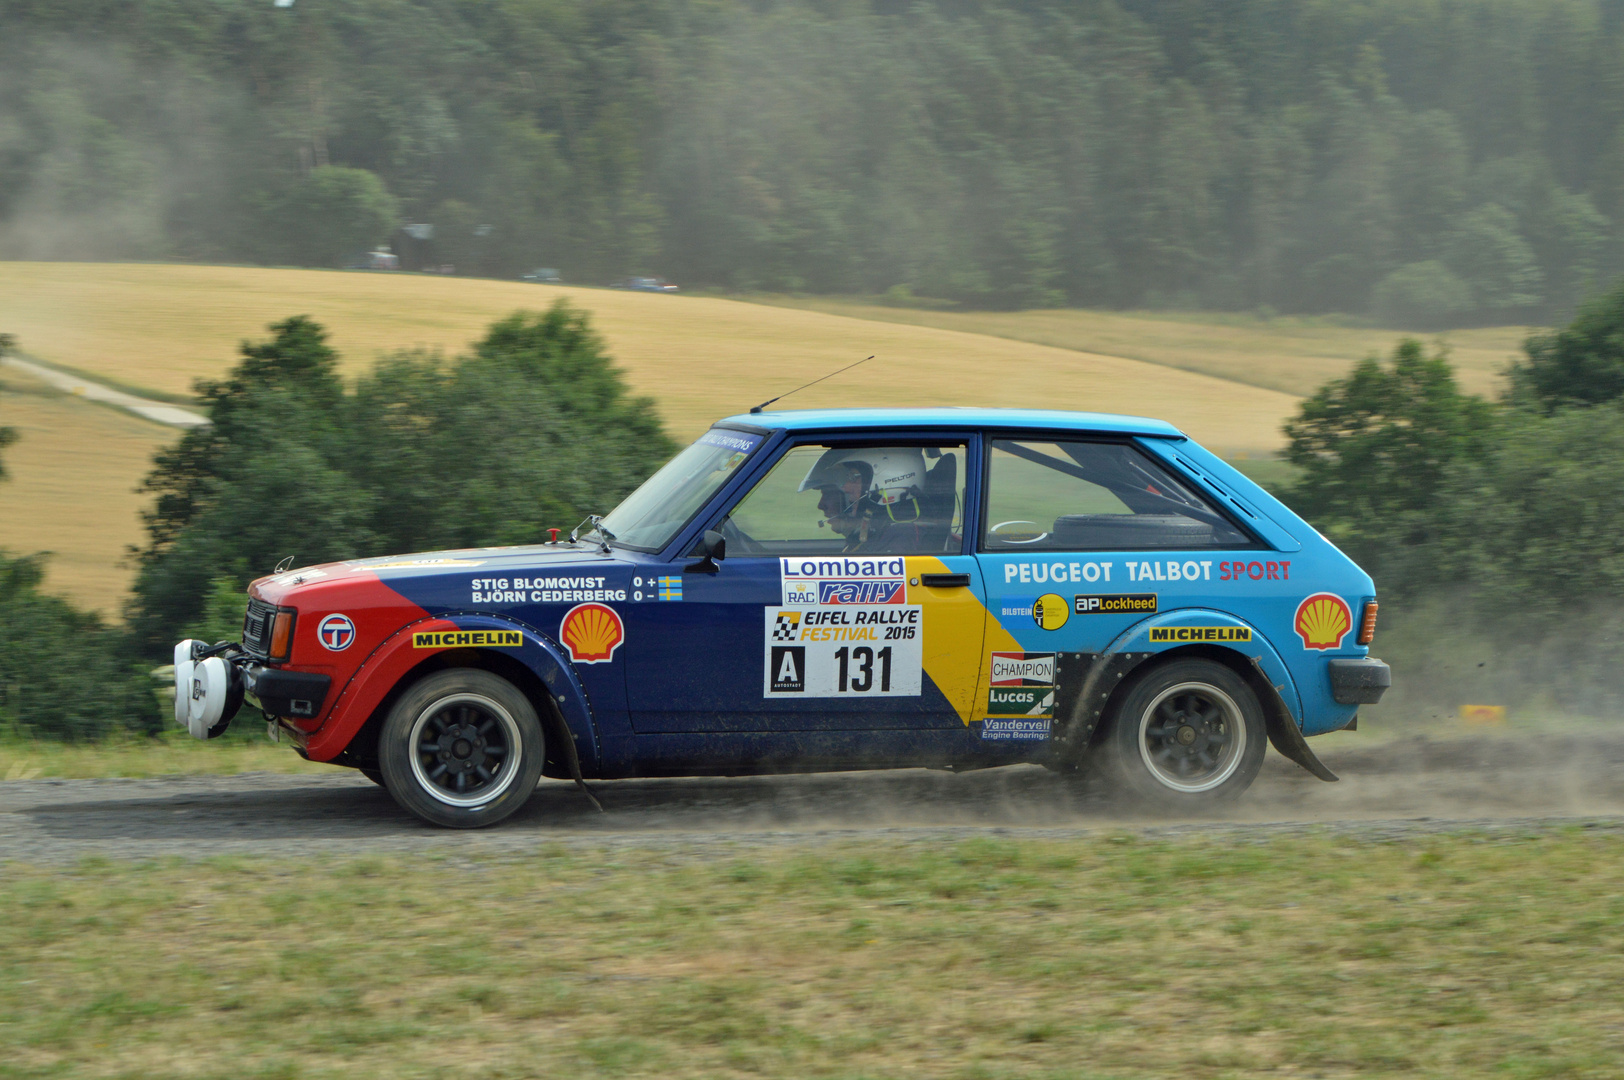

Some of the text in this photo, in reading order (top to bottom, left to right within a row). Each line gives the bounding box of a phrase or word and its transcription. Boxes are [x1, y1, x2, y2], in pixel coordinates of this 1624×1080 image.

[884, 472, 916, 484] PELTOR
[783, 558, 904, 576] Lombard
[1004, 561, 1291, 583] PEUGEOT TALBOT SPORT
[471, 579, 509, 590] STIG
[513, 577, 606, 589] BLOMQVIST
[472, 588, 526, 603] BJÖRN
[530, 589, 627, 602] CEDERBERG
[787, 592, 815, 603] RAC
[821, 582, 905, 604] rally
[804, 610, 920, 625] EIFEL RALLYE
[1002, 607, 1033, 616] BILSTEIN
[416, 632, 520, 647] MICHELIN
[800, 626, 916, 641] FESTIVAL 2015
[1151, 628, 1249, 641] MICHELIN
[777, 650, 798, 682] A
[834, 646, 892, 693] 131
[993, 663, 1052, 676] CHAMPION
[989, 690, 1034, 703] Lucas
[984, 719, 1051, 730] Vandervell
[982, 731, 1011, 740] Engine
